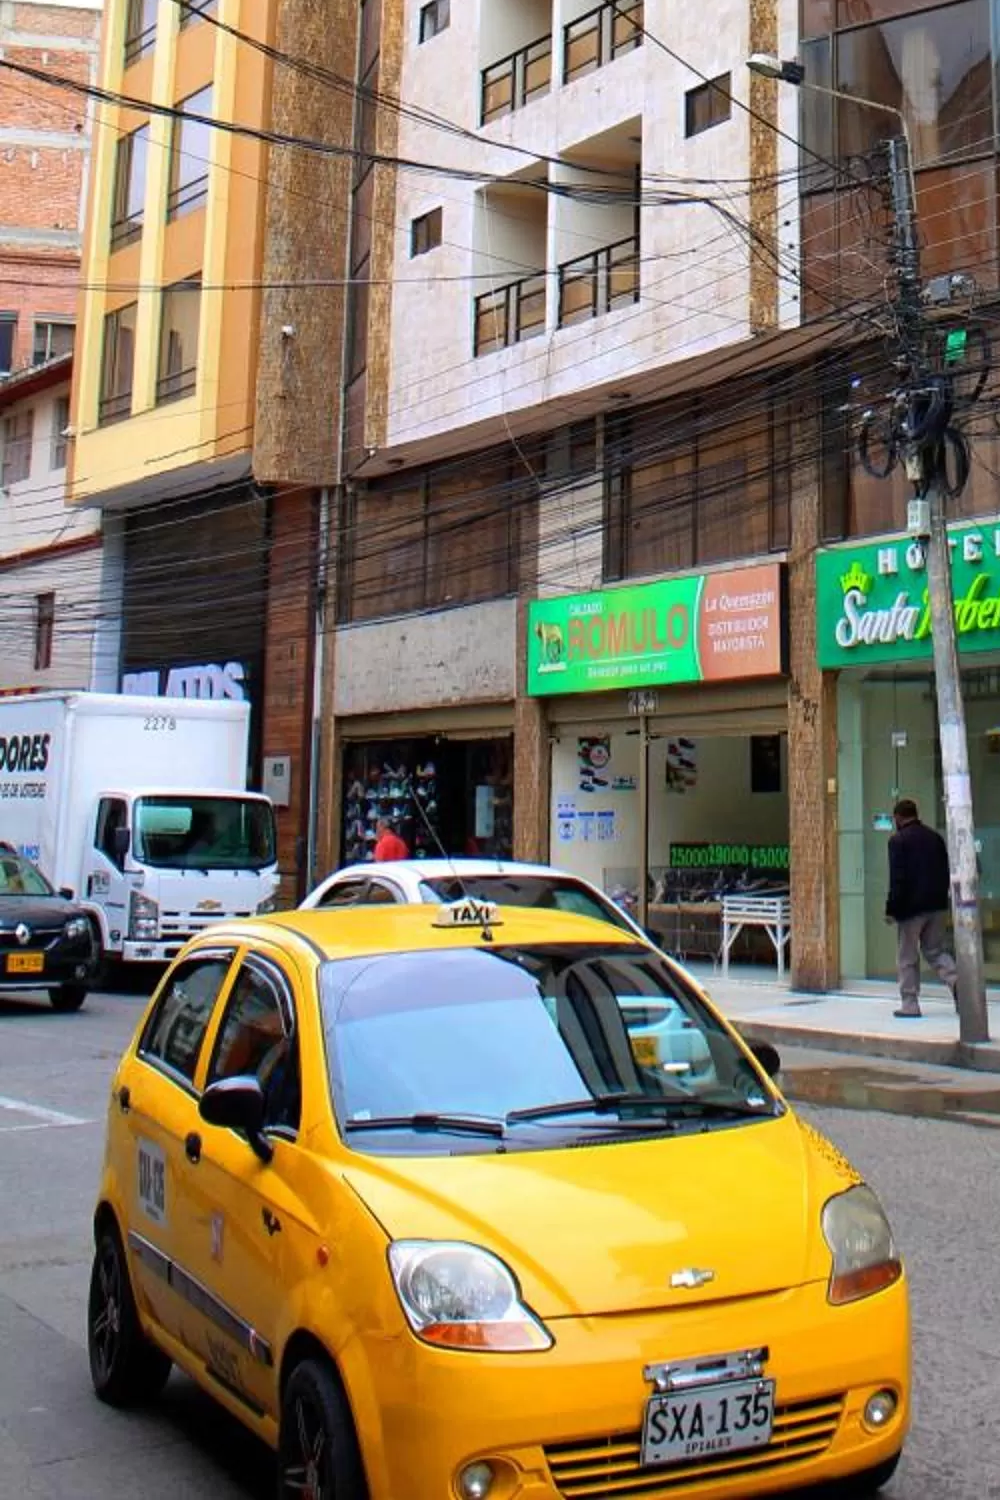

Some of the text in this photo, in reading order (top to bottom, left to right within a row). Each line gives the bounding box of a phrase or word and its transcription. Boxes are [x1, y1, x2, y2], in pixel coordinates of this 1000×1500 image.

[835, 589, 921, 648] Santa
[567, 603, 689, 660] ROMULO
[143, 717, 177, 731] 2278
[451, 906, 490, 921] TAXI
[686, 1436, 732, 1454] IPIALES
